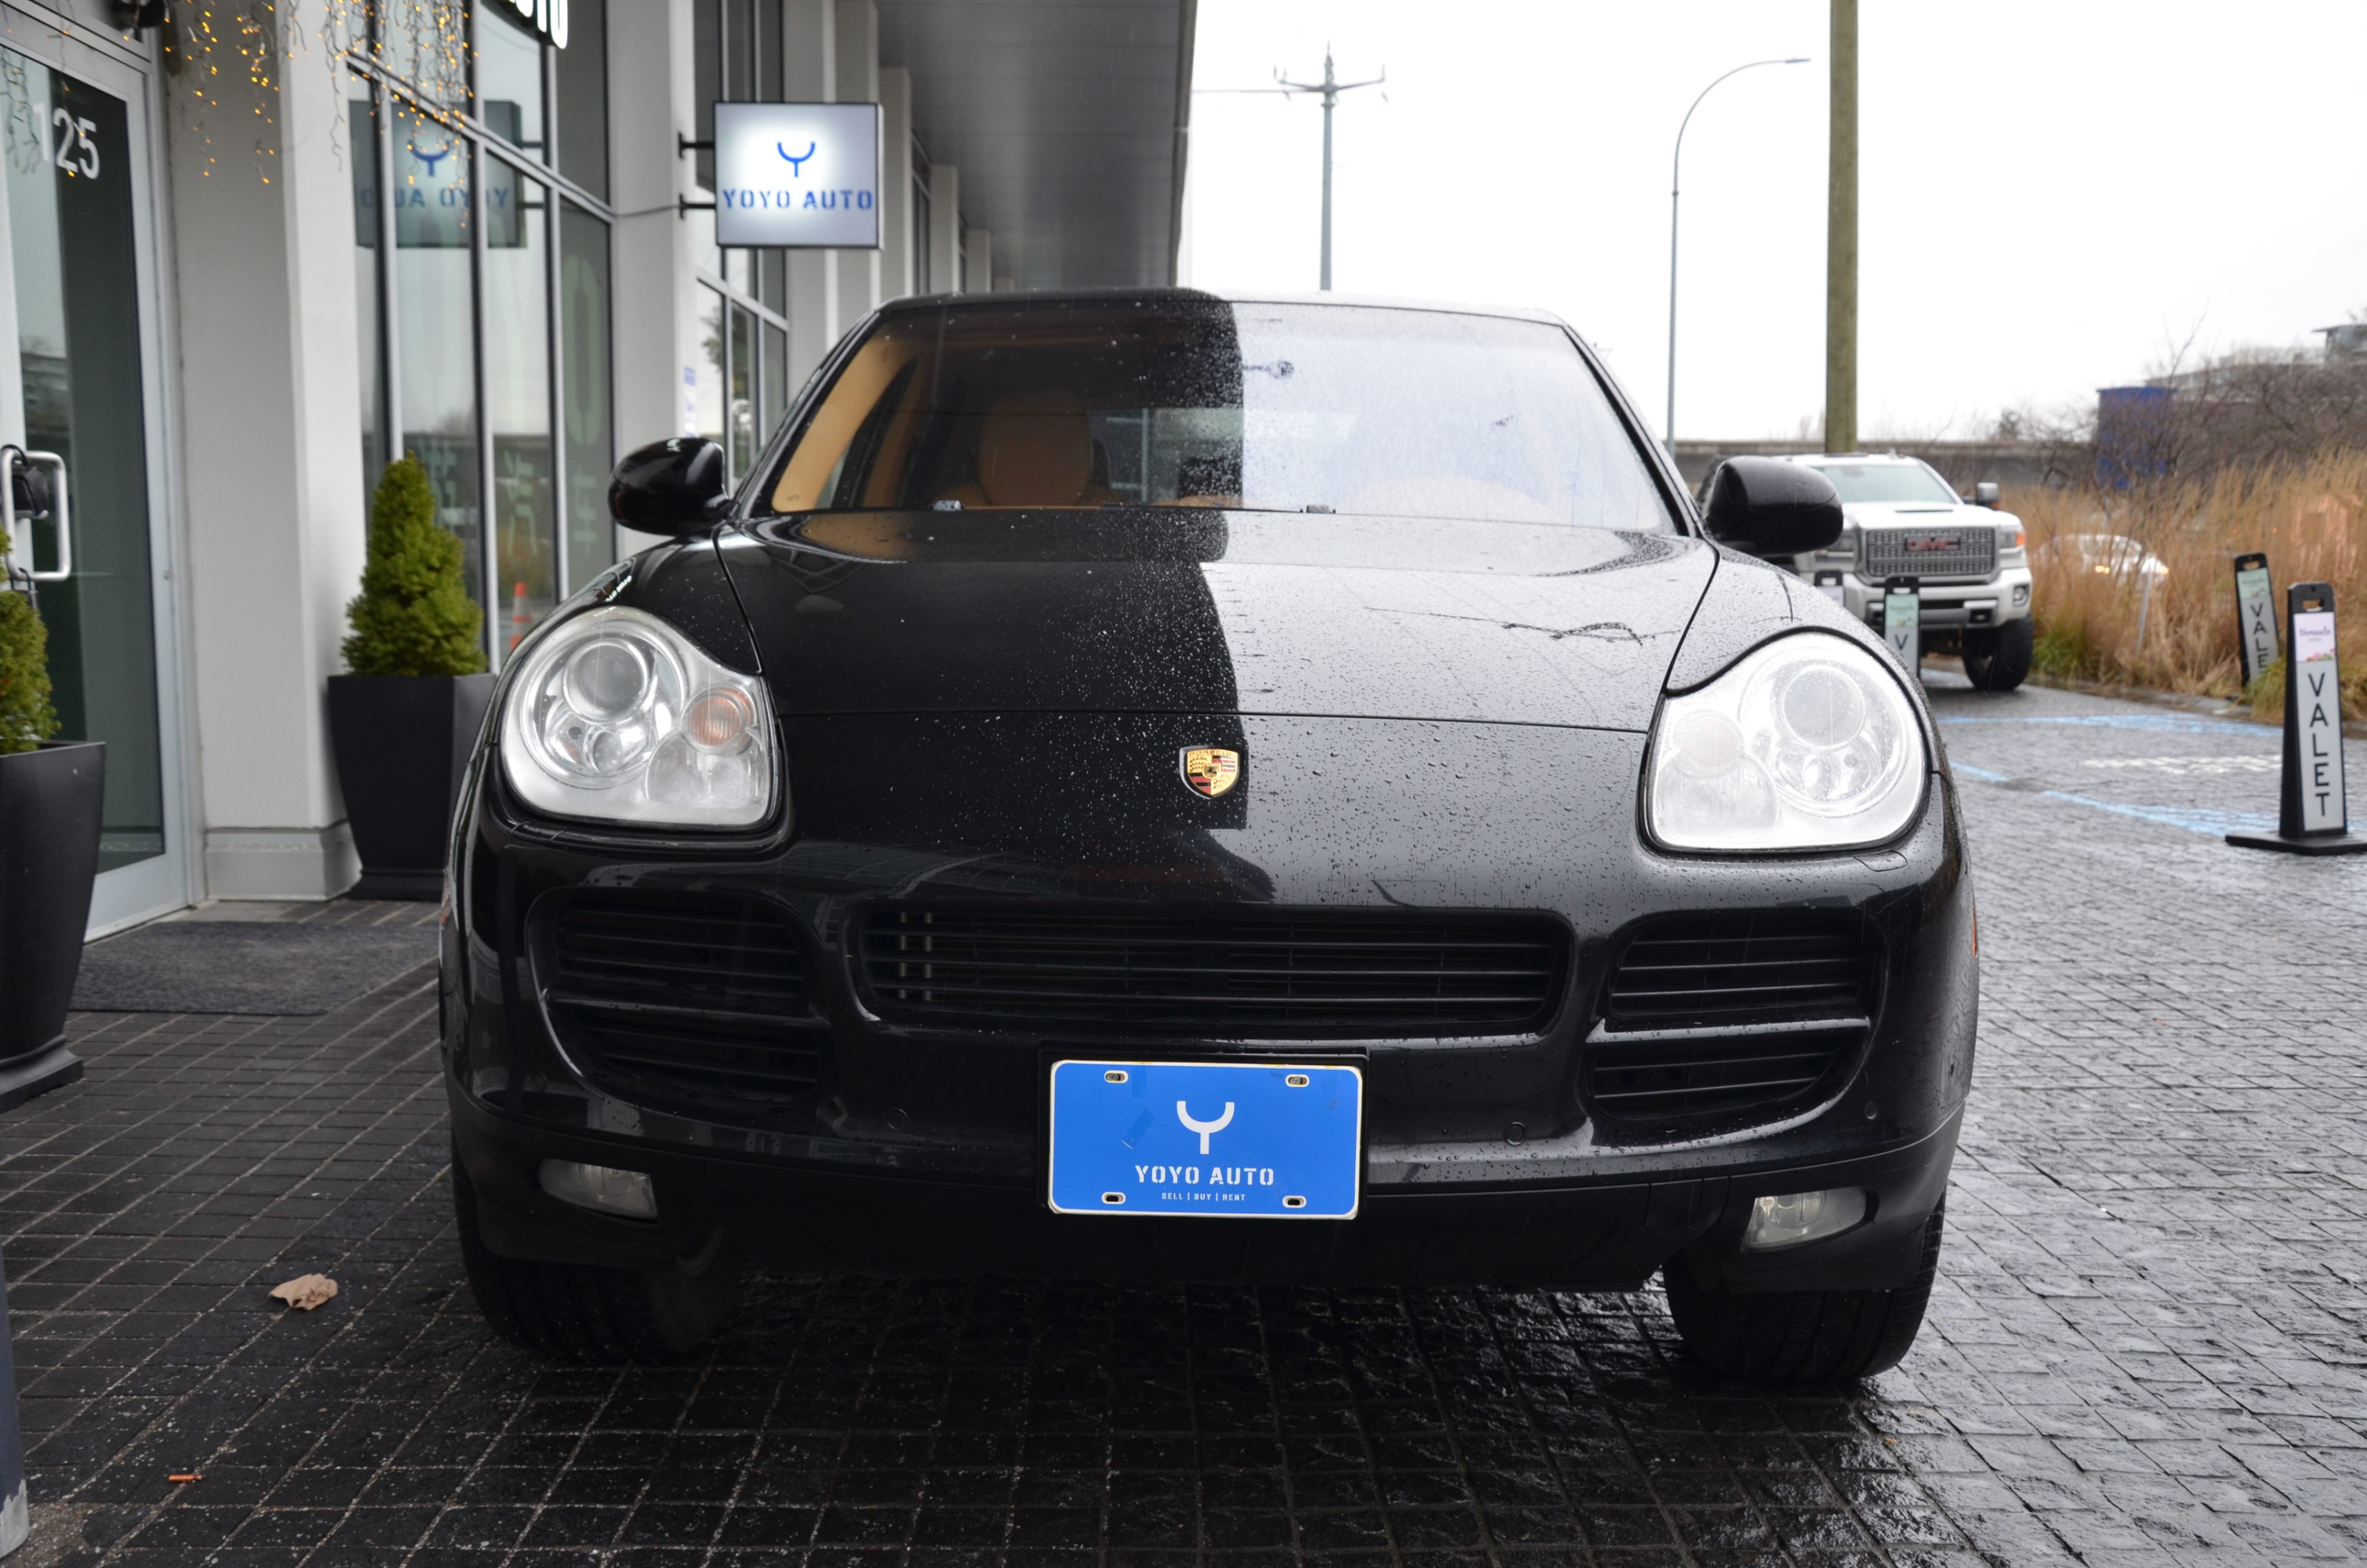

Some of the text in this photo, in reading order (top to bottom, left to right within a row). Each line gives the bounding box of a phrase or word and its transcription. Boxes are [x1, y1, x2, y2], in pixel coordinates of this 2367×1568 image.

[32, 103, 100, 179] 125
[722, 189, 873, 209] YOYO AUTO
[1907, 538, 1959, 551] GMC
[2308, 672, 2329, 817] VALET
[1135, 1165, 1274, 1186] YOYO AUTO
